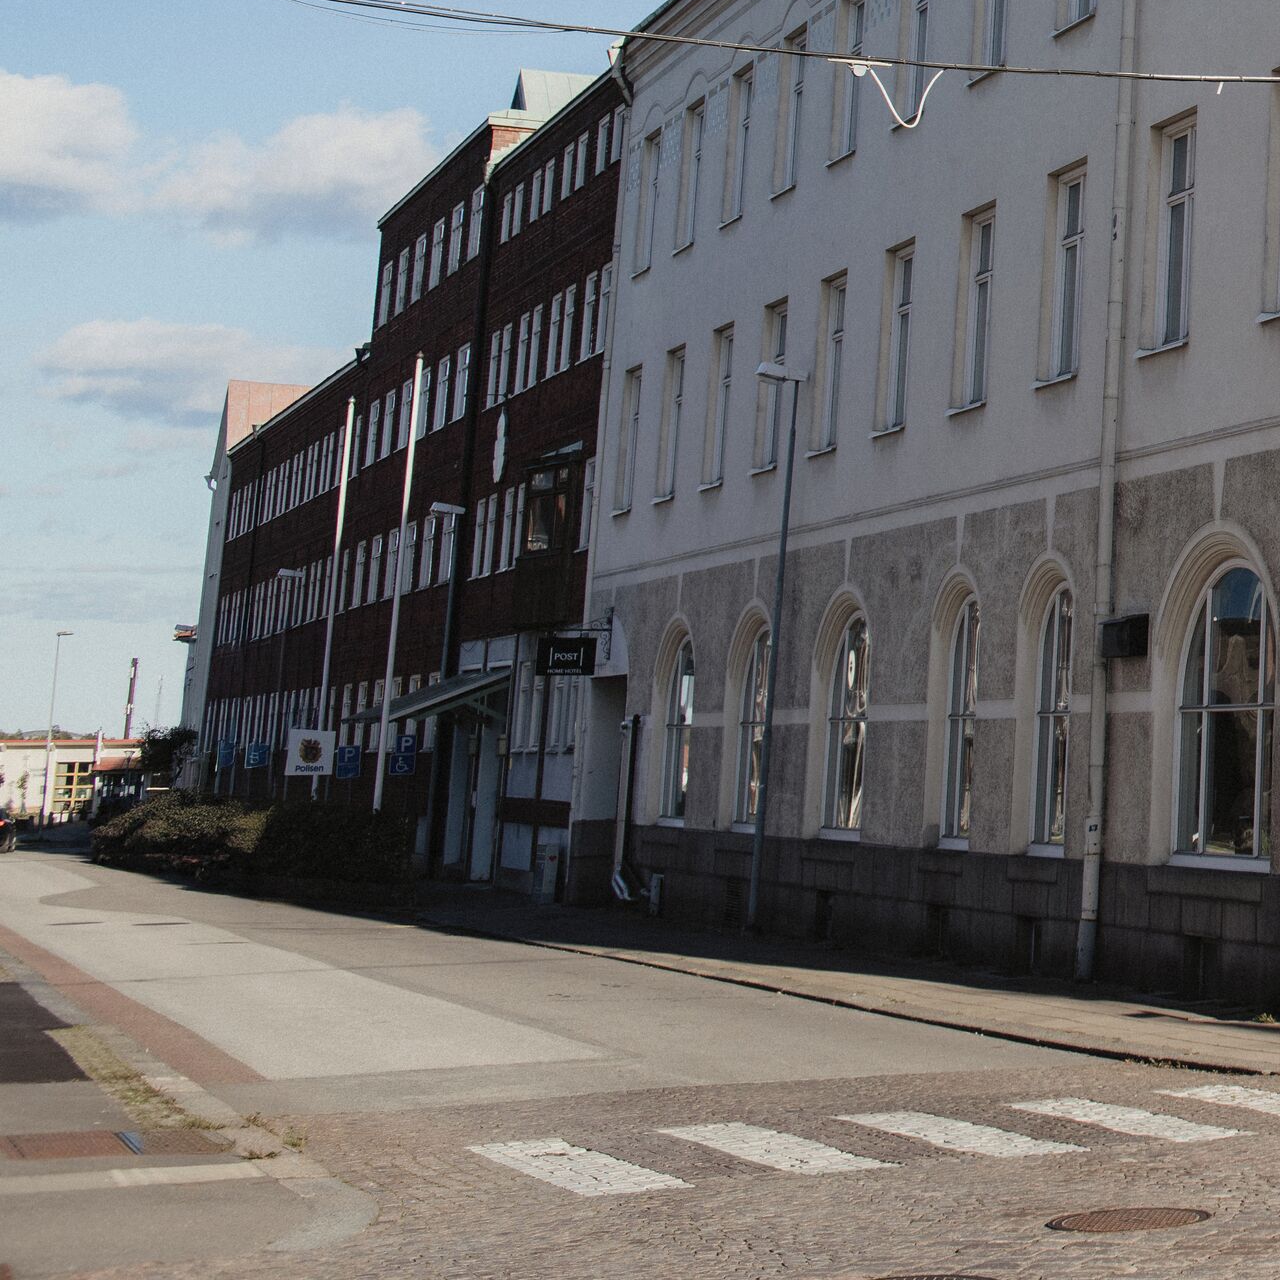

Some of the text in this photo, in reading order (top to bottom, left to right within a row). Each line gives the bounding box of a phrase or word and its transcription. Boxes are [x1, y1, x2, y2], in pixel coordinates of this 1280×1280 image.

[554, 652, 578, 661] POST
[401, 736, 413, 752] P
[344, 747, 356, 762] P
[295, 765, 324, 773] Polisen
